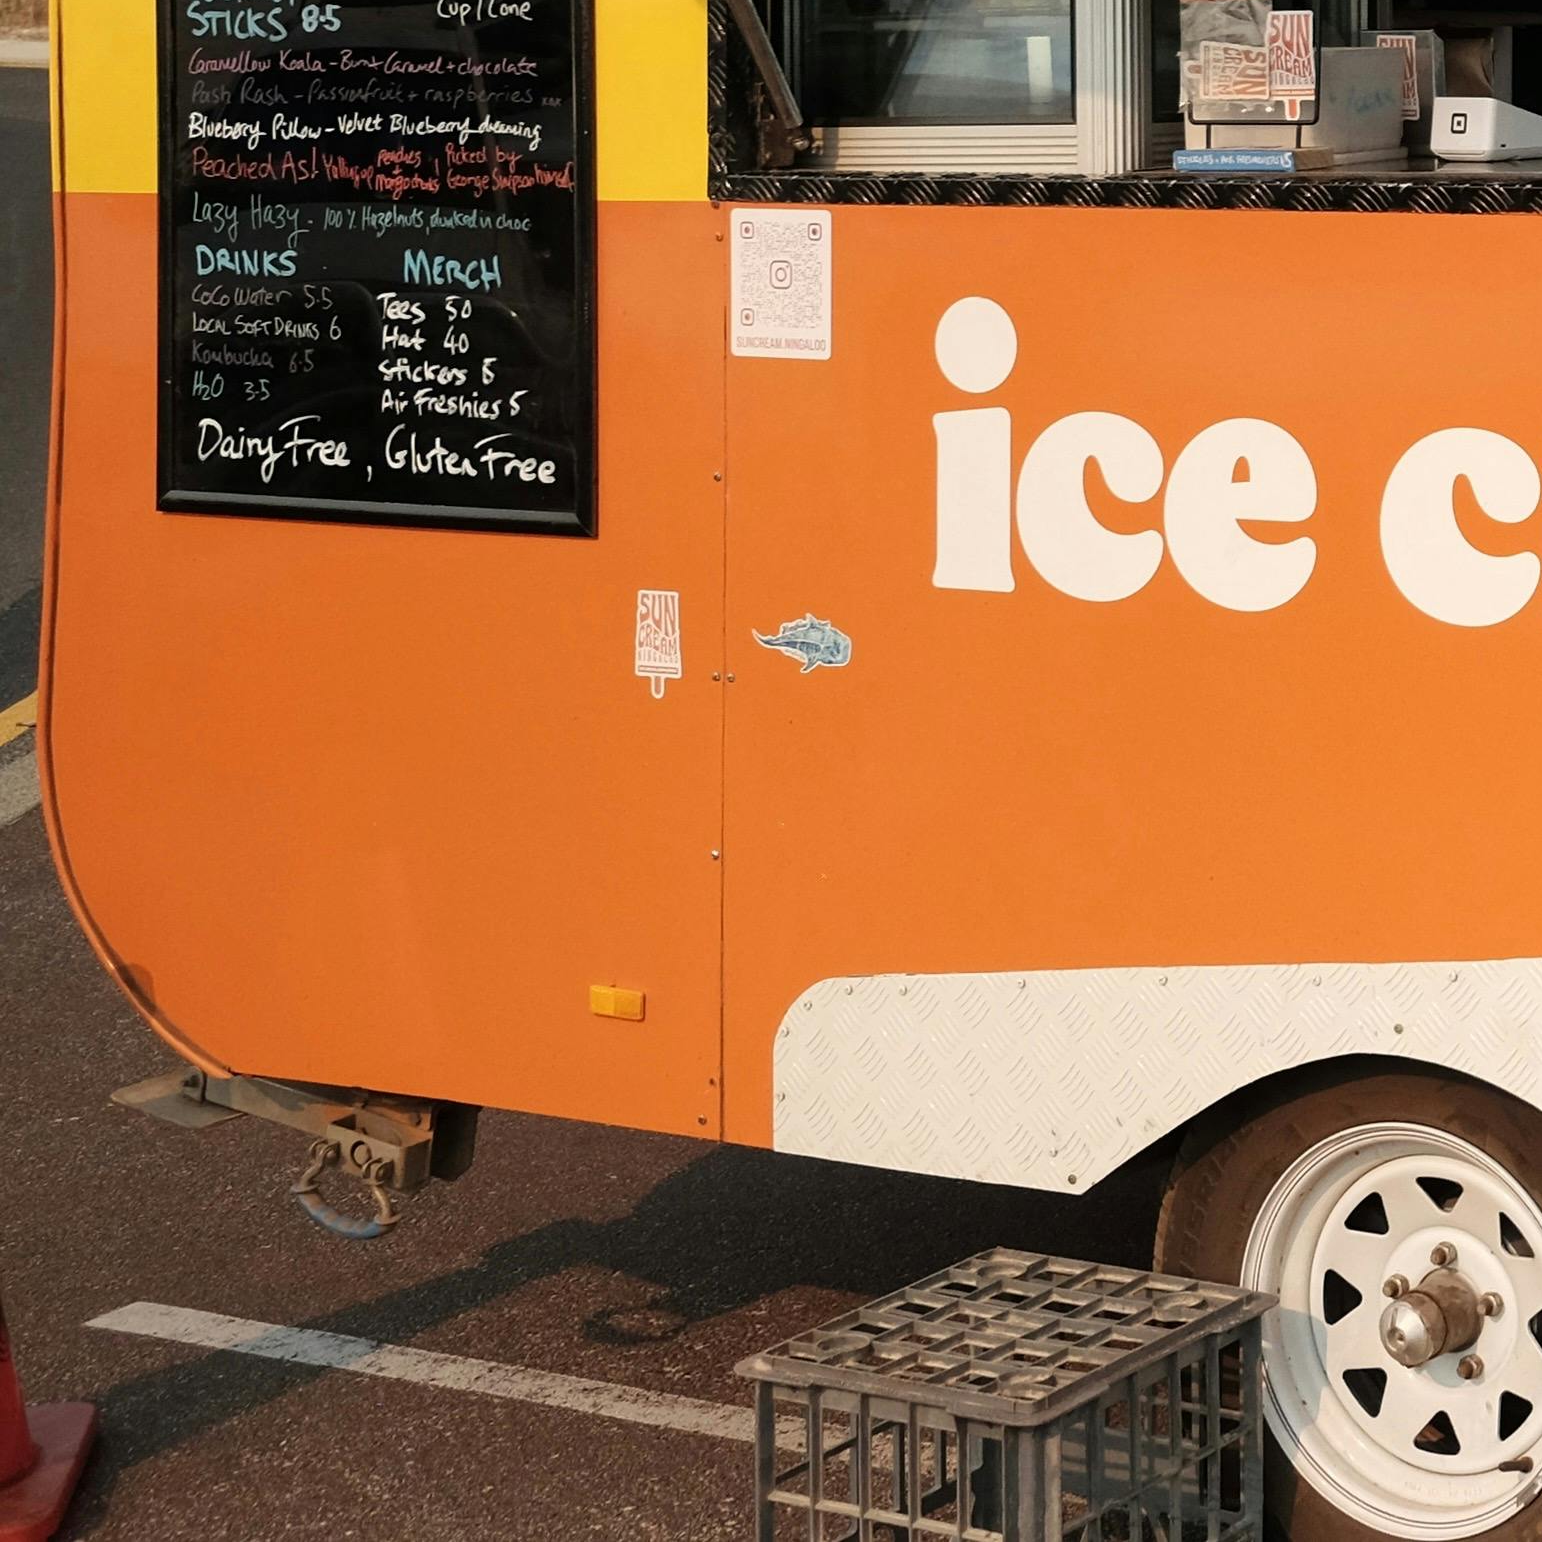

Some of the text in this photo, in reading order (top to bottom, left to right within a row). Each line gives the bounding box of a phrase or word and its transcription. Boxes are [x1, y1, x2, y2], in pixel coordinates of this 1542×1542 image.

[186, 1, 288, 42] STICKS
[1269, 13, 1311, 59] SUN
[279, 48, 327, 73] Koala
[340, 49, 384, 72] Burnt
[384, 51, 445, 75] Caramel
[456, 56, 538, 77] chocolate
[1233, 49, 1267, 96] SUN
[1268, 45, 1313, 78] CREAM
[192, 80, 232, 105] Pash
[240, 77, 289, 106] Rash
[423, 83, 535, 110] raspberries
[188, 111, 266, 150] Blueberry
[272, 113, 323, 140] Pillow
[337, 111, 384, 135] Velvet
[389, 114, 472, 145] Blueberry
[478, 114, 542, 151] dreaming
[192, 145, 277, 181] Peached
[495, 147, 523, 174] by
[192, 190, 239, 243] Lazy
[250, 193, 309, 248] Hazy
[495, 213, 532, 232] choc
[195, 244, 298, 277] DRINKS
[403, 248, 502, 293] MERCH
[376, 292, 473, 325] Tees 50
[192, 311, 343, 341] LOCAL SOFT DRINKS 6
[381, 324, 471, 356] Hat 40
[481, 357, 498, 386] 5
[381, 387, 530, 421] Air Freshies 5
[197, 417, 286, 485] Dairy
[384, 423, 478, 476] Gluten
[473, 432, 558, 485] Free
[932, 295, 1318, 612] ice
[639, 593, 677, 638] SUN
[637, 622, 678, 656] CREAM
